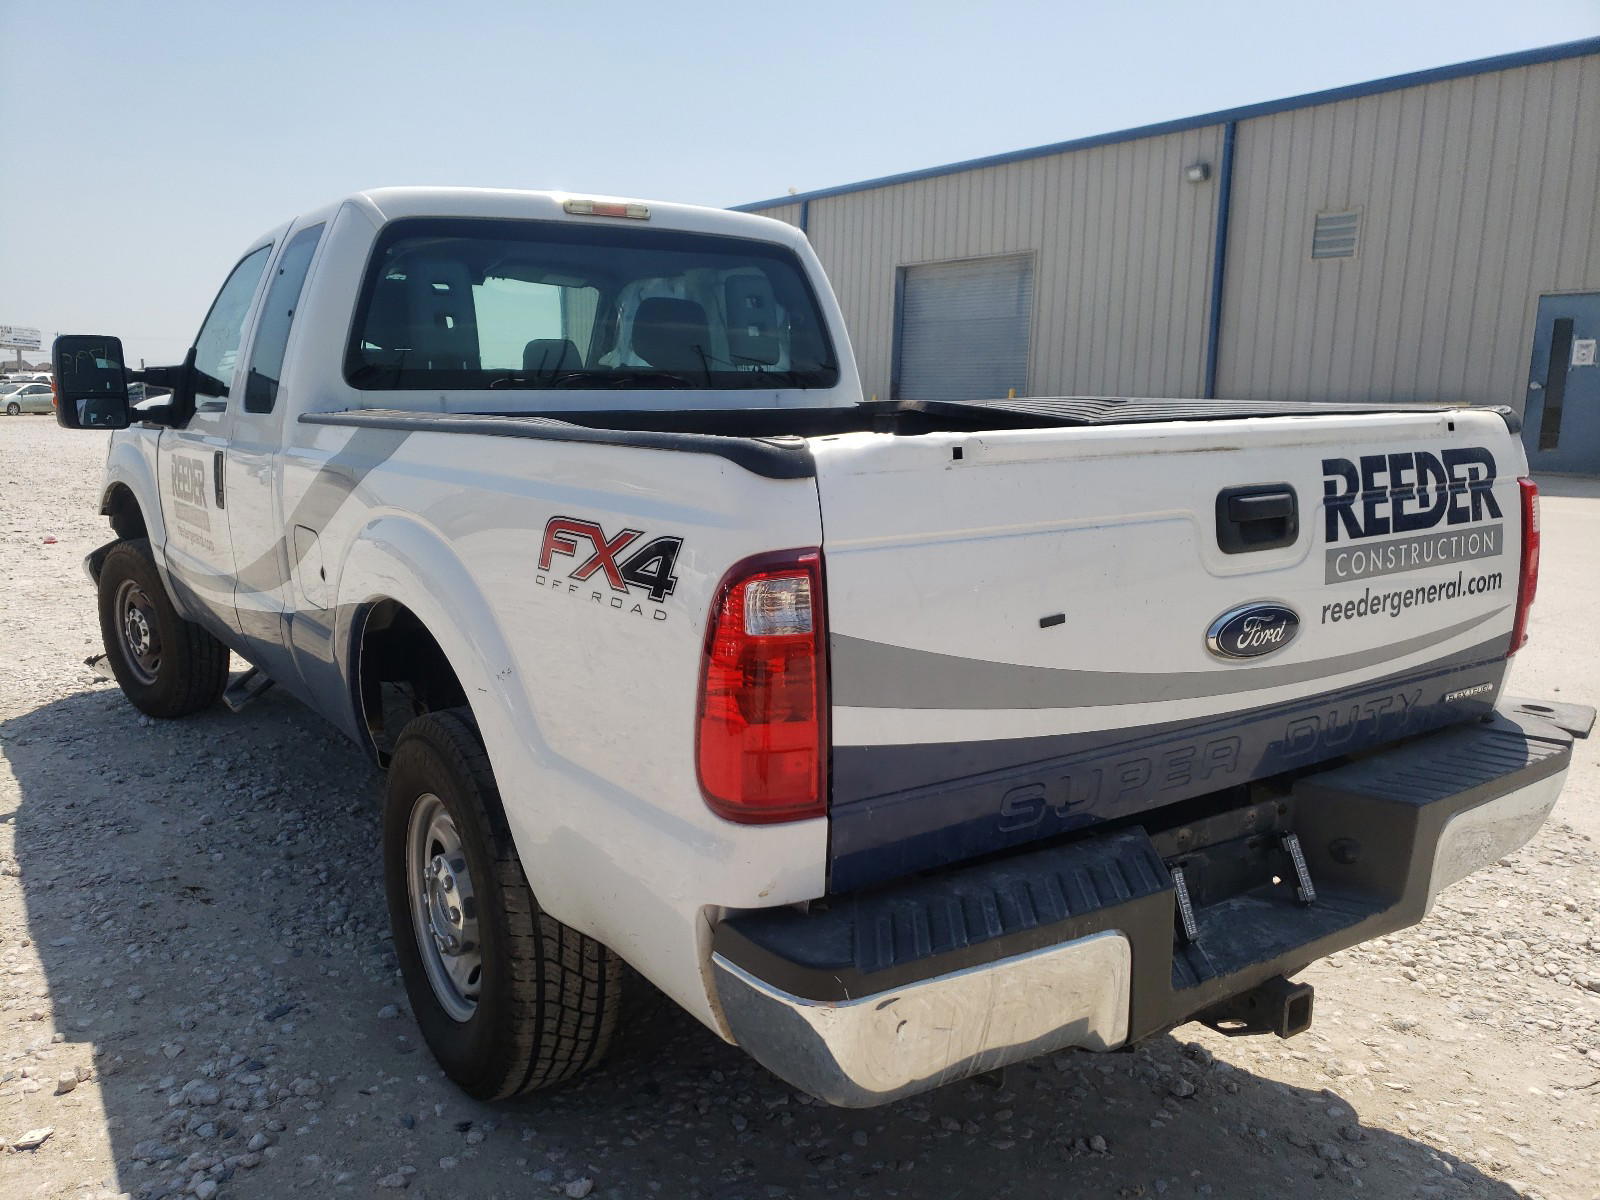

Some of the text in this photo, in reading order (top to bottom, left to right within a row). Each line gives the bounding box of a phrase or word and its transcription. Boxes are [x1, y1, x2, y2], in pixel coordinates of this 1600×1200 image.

[1321, 446, 1504, 544] REEDER
[538, 515, 684, 604] FX4
[1335, 530, 1495, 577] CONSTRUCTION
[535, 574, 667, 621] OFF ROAD
[1321, 570, 1502, 625] reedergeneral.com
[1236, 614, 1287, 649] Ford
[999, 688, 1423, 833] SUPER DUTY
